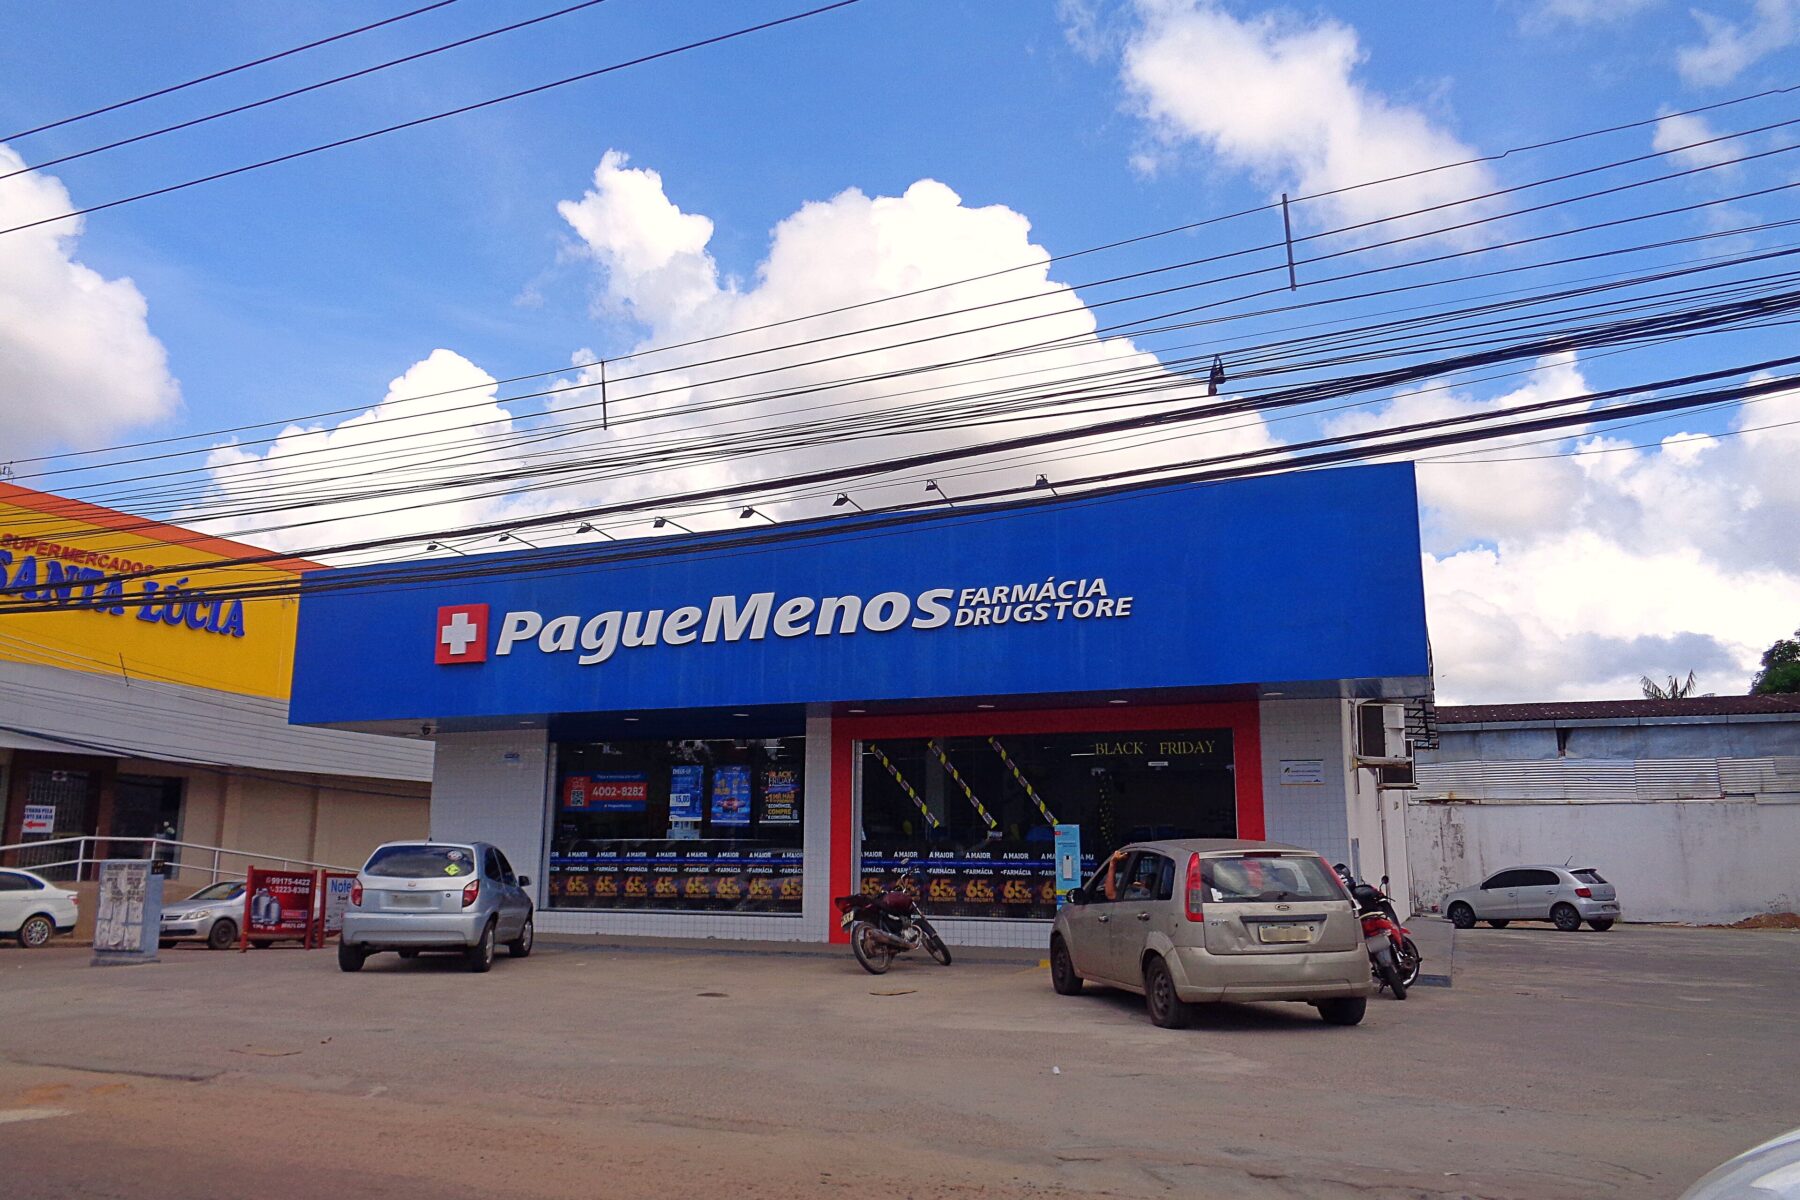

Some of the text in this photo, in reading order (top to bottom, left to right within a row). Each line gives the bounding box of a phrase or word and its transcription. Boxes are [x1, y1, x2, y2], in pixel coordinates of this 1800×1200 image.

[959, 576, 1108, 607] FARMÁCIA
[137, 577, 245, 639] LÚCIA
[954, 596, 1134, 627] DRUGSTORE
[495, 588, 955, 666] PagueMenos
[1095, 741, 1215, 755] BLACK FRIDAY
[592, 786, 644, 796] 4002-8282
[781, 878, 801, 895] 65
[862, 878, 881, 895] 65
